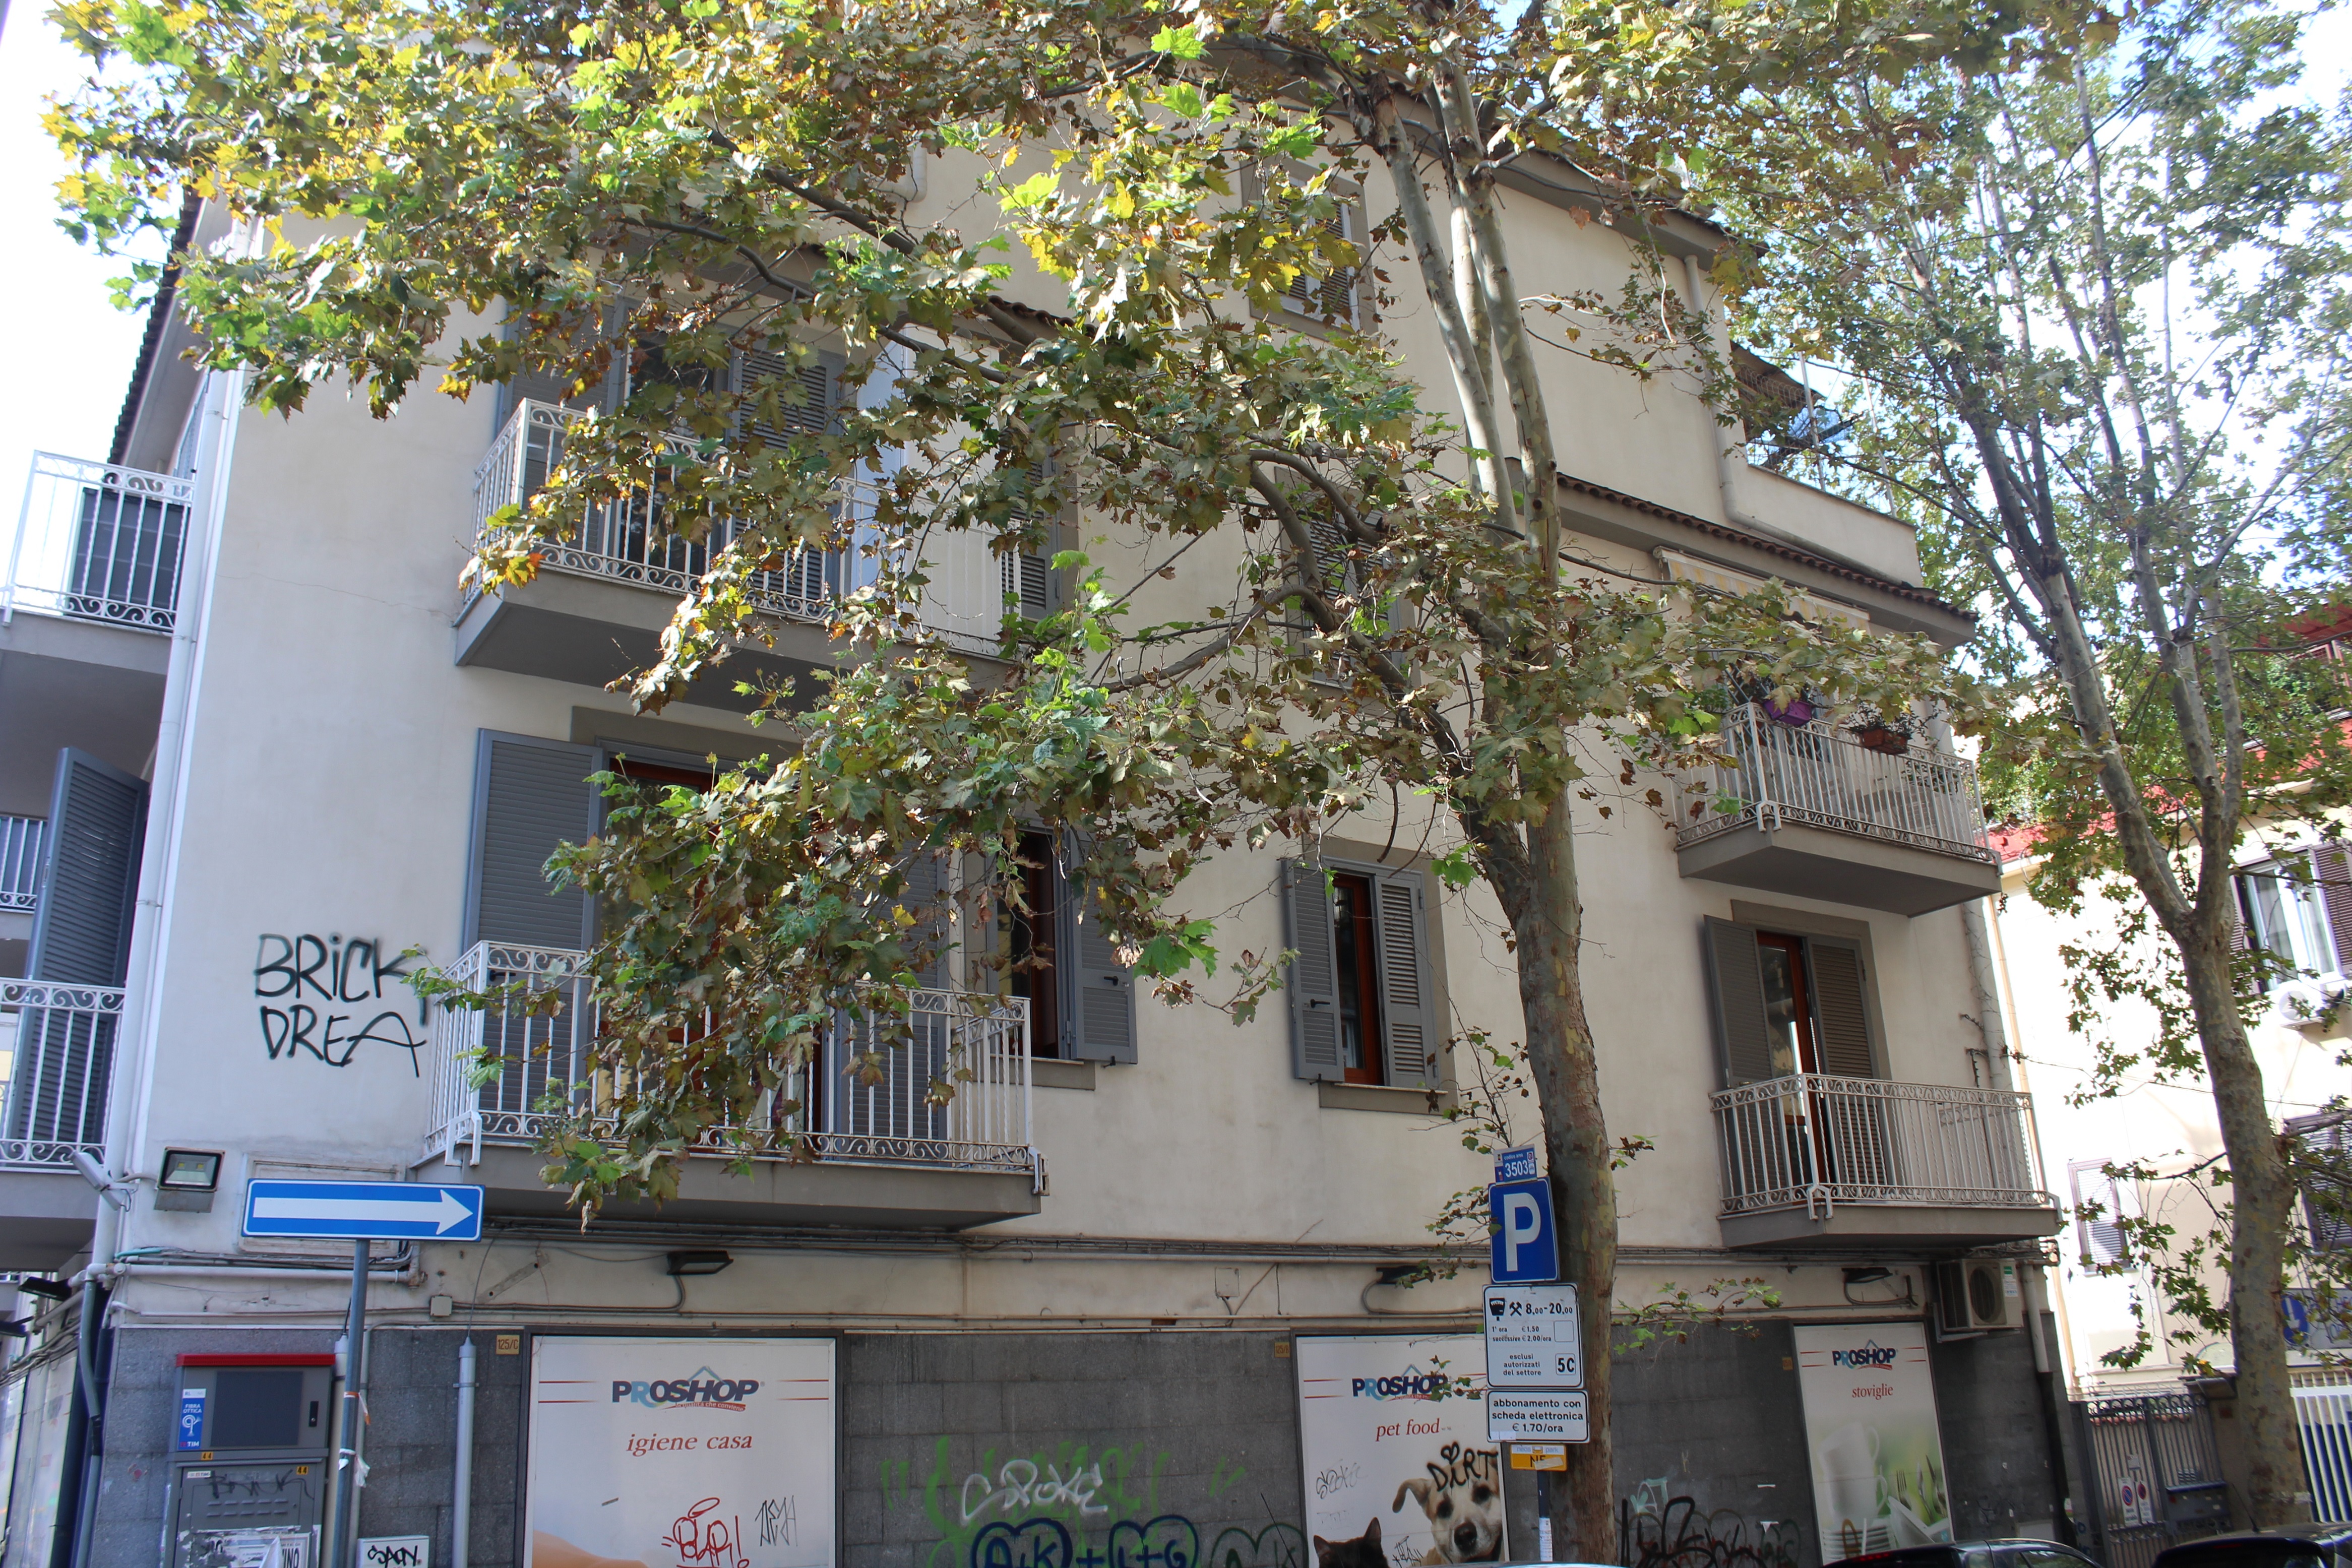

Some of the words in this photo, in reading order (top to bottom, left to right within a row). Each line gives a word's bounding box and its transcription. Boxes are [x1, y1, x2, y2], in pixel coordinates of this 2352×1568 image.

[1505, 1160, 1528, 1178] 3503
[1504, 1193, 1541, 1271] P
[498, 1339, 518, 1350] 125/C
[1558, 1357, 1574, 1372] 5C
[1832, 1348, 1896, 1368] PROSHOP
[612, 1379, 759, 1407] PROSHOP
[1352, 1375, 1448, 1399] PROSHOP
[1852, 1384, 1893, 1400] stoviglie
[718, 1403, 744, 1412] conviene
[1494, 1399, 1560, 1408] abbonamento
[1492, 1411, 1525, 1419] scheda
[1529, 1412, 1583, 1420] elettronica
[1376, 1422, 1400, 1441] pet
[1405, 1417, 1440, 1435] food
[626, 1433, 698, 1457] igiene
[707, 1436, 753, 1450] casa
